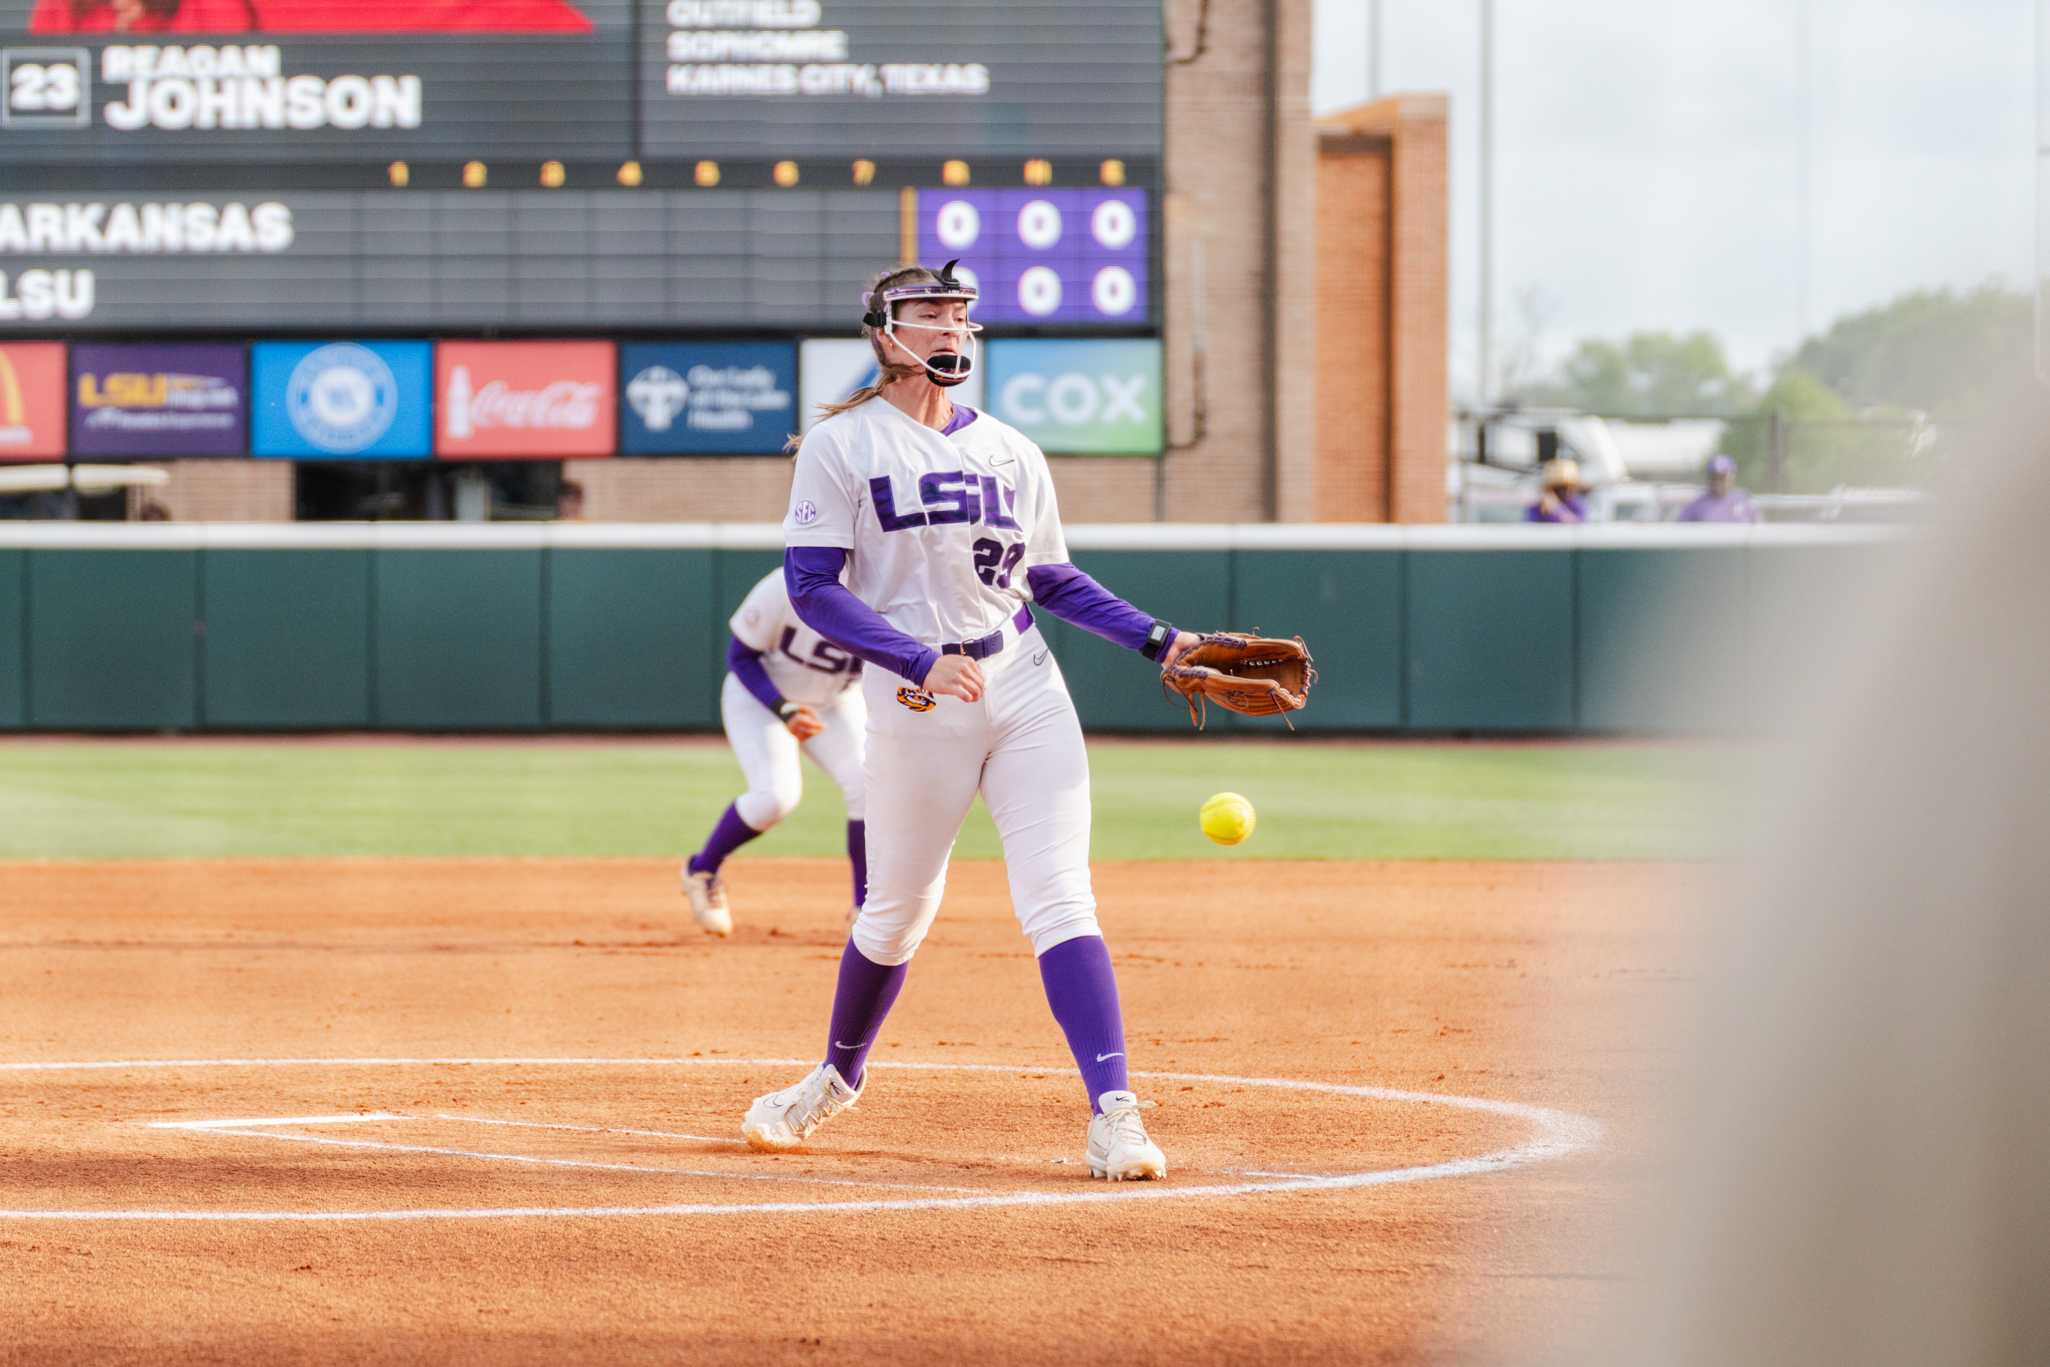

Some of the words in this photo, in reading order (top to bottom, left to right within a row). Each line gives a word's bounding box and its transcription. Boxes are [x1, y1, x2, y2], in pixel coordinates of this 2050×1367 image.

[11, 63, 81, 110] 23
[102, 45, 281, 82] REAGAN
[879, 63, 990, 95] TEXAS
[103, 75, 422, 130] JOHNSON
[0, 202, 293, 253] ARKANSAS
[936, 200, 980, 249] 0
[1017, 200, 1062, 249] 0
[1091, 200, 1136, 249] 0
[1018, 266, 1062, 316] 0
[1091, 266, 1136, 316] 0
[80, 372, 167, 408] LSU
[1002, 372, 1147, 423] COX
[794, 500, 817, 524] SEC
[868, 470, 1024, 533] LSU
[779, 625, 864, 675] LS
